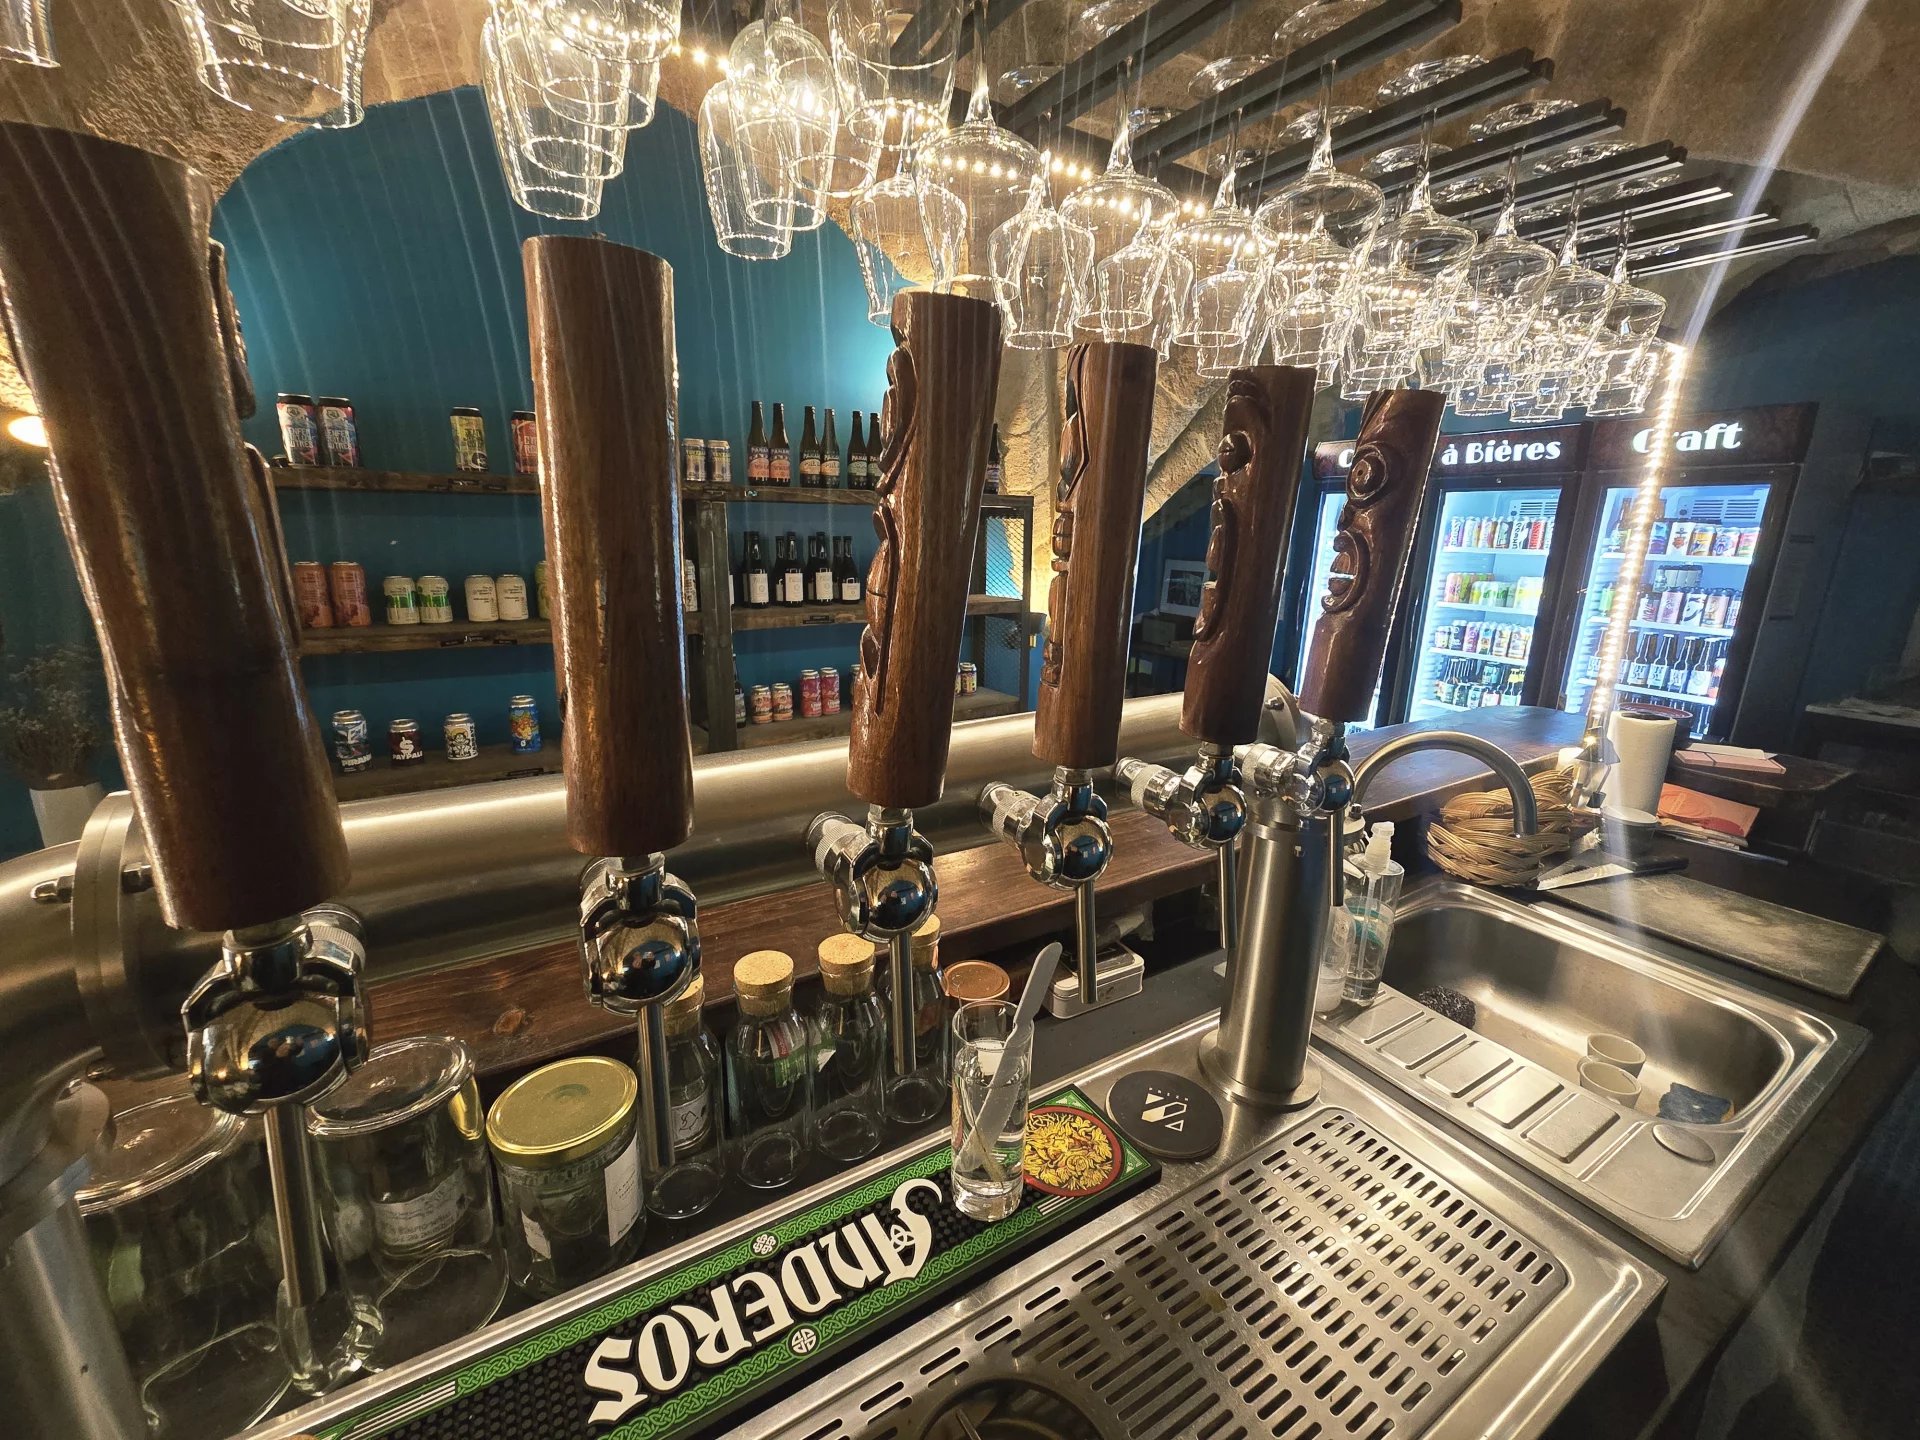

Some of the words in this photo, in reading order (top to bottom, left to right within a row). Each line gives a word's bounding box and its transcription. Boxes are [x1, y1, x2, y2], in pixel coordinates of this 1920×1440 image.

[1441, 443, 1459, 466] à
[1464, 439, 1562, 464] Bières
[1633, 423, 1742, 454] Caft
[584, 1178, 942, 1424] ANDEROS
